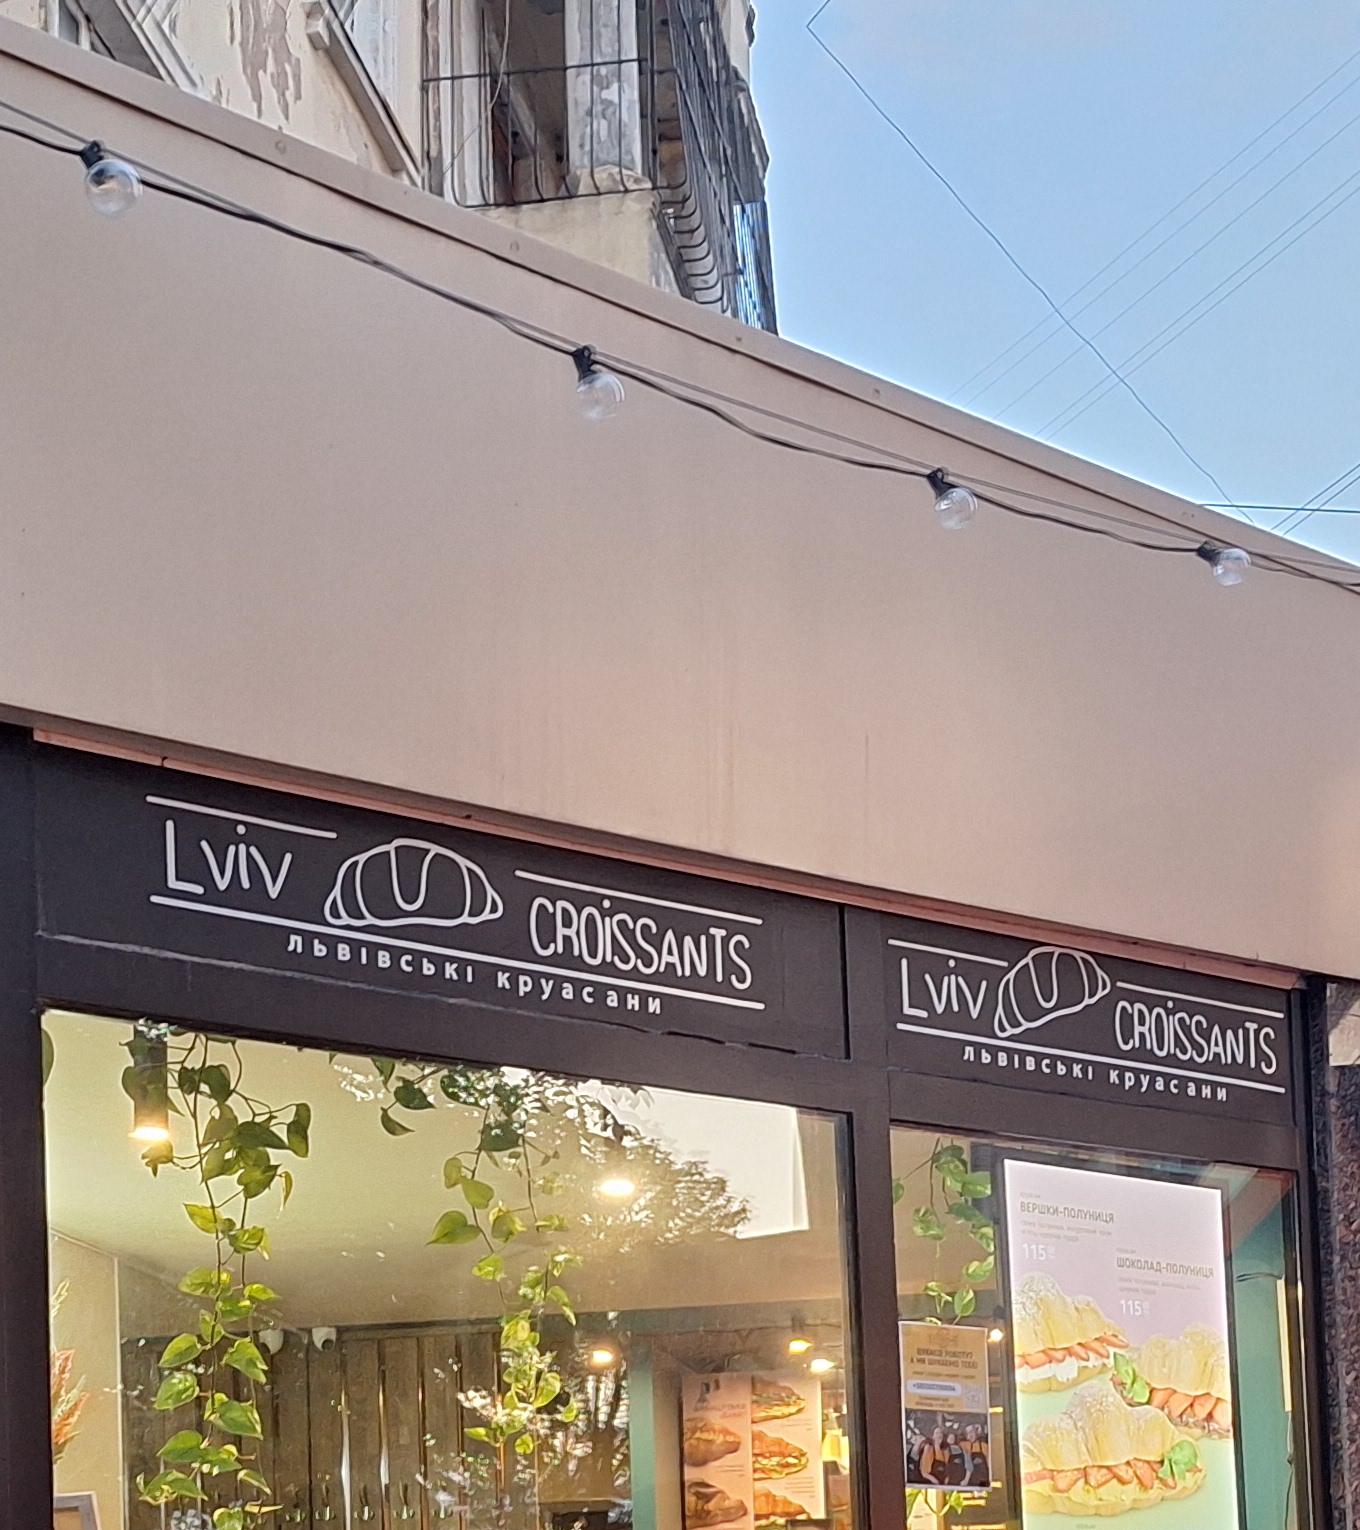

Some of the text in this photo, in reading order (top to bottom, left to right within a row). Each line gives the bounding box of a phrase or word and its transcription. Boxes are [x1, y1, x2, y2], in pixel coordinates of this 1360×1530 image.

[528, 897, 753, 991] CROISSANTS
[286, 932, 663, 1017] львівські круасани
[1114, 999, 1278, 1075] CROISSANTS
[962, 1044, 1229, 1103] львівські круасани
[1019, 1200, 1115, 1224] ВЕРШКИ-ПОЛУНИЦЯ
[1021, 1242, 1047, 1261] 115
[1116, 1256, 1215, 1279] ШОКОЛАД-ПОЛУНИЦЯ
[1119, 1299, 1142, 1316] 115
